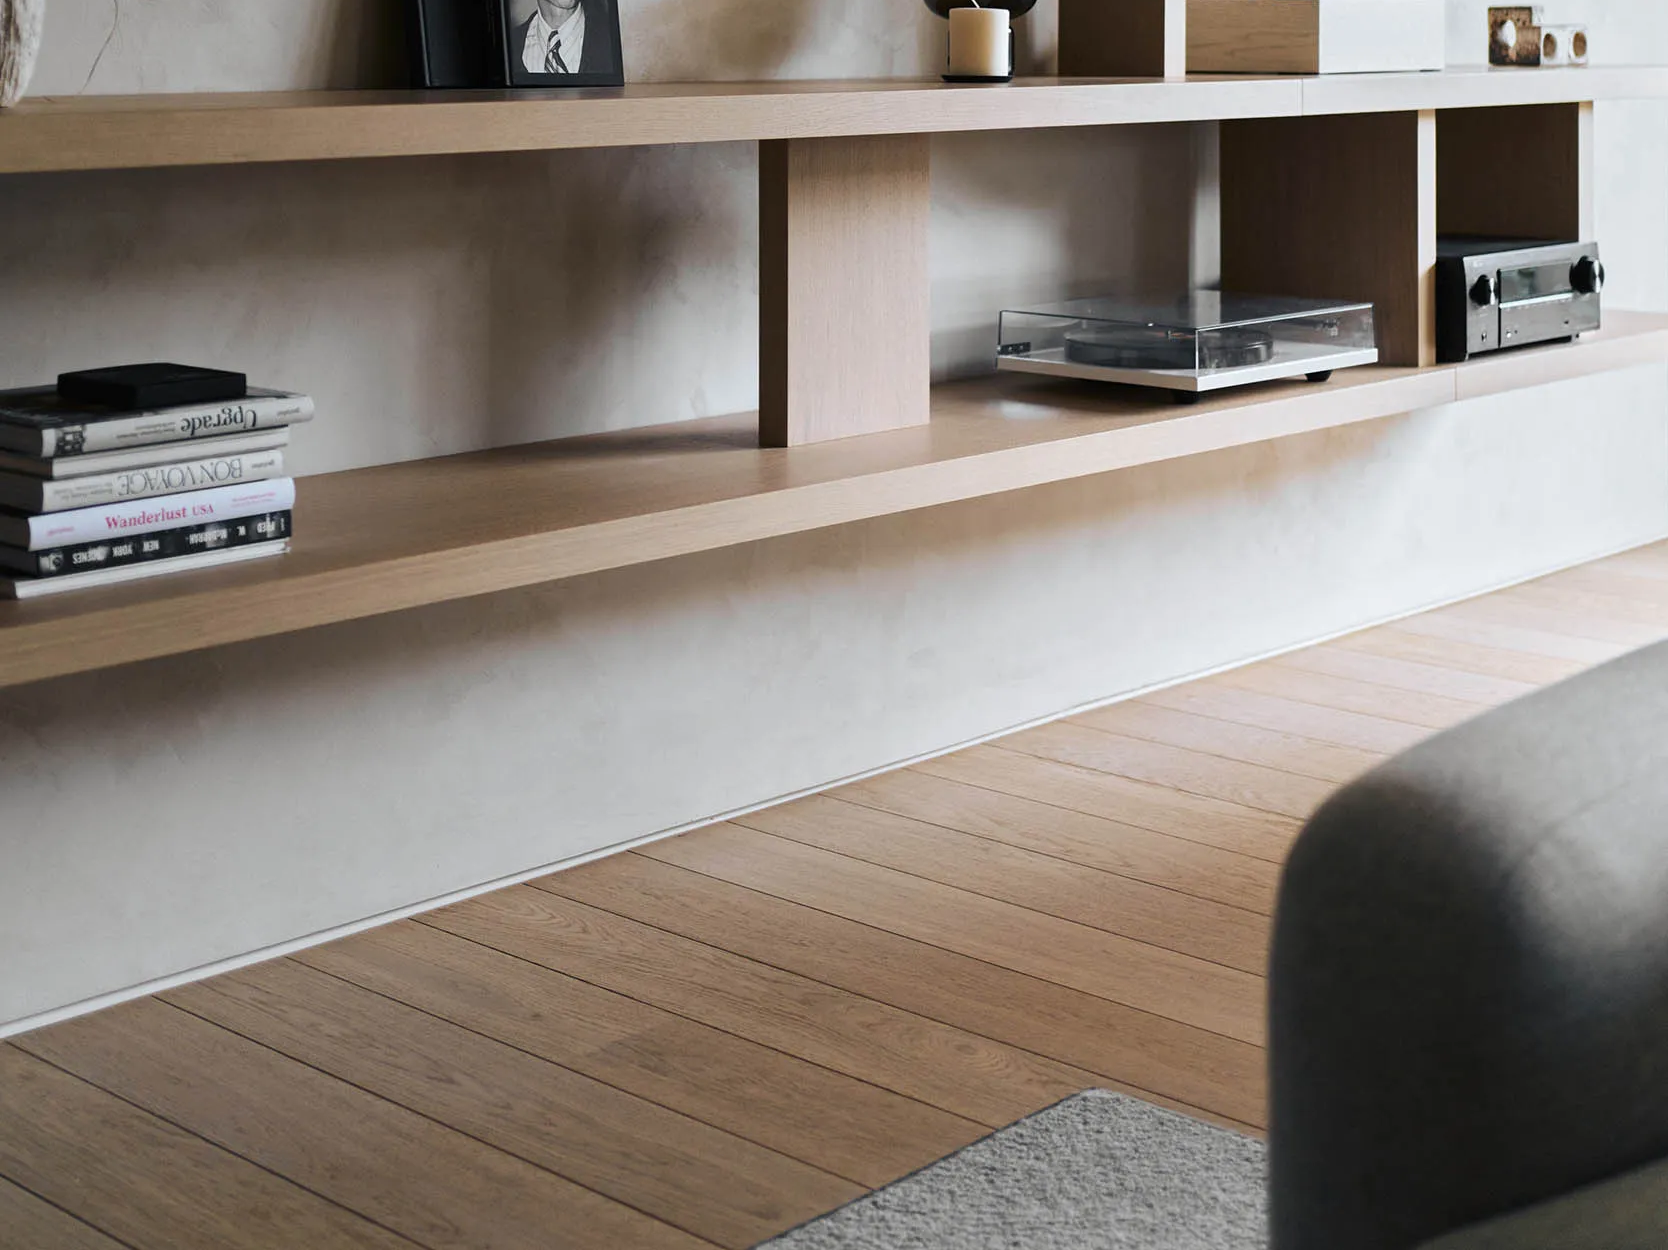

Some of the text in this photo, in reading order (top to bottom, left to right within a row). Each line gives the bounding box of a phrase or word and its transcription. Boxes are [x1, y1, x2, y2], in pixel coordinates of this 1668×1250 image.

[181, 406, 257, 436] Upgrade
[117, 465, 195, 496] VOYAGE
[200, 458, 243, 484] BON
[105, 504, 214, 529] Wanderlust USA
[112, 543, 133, 557] YORK
[143, 539, 160, 552] NEW
